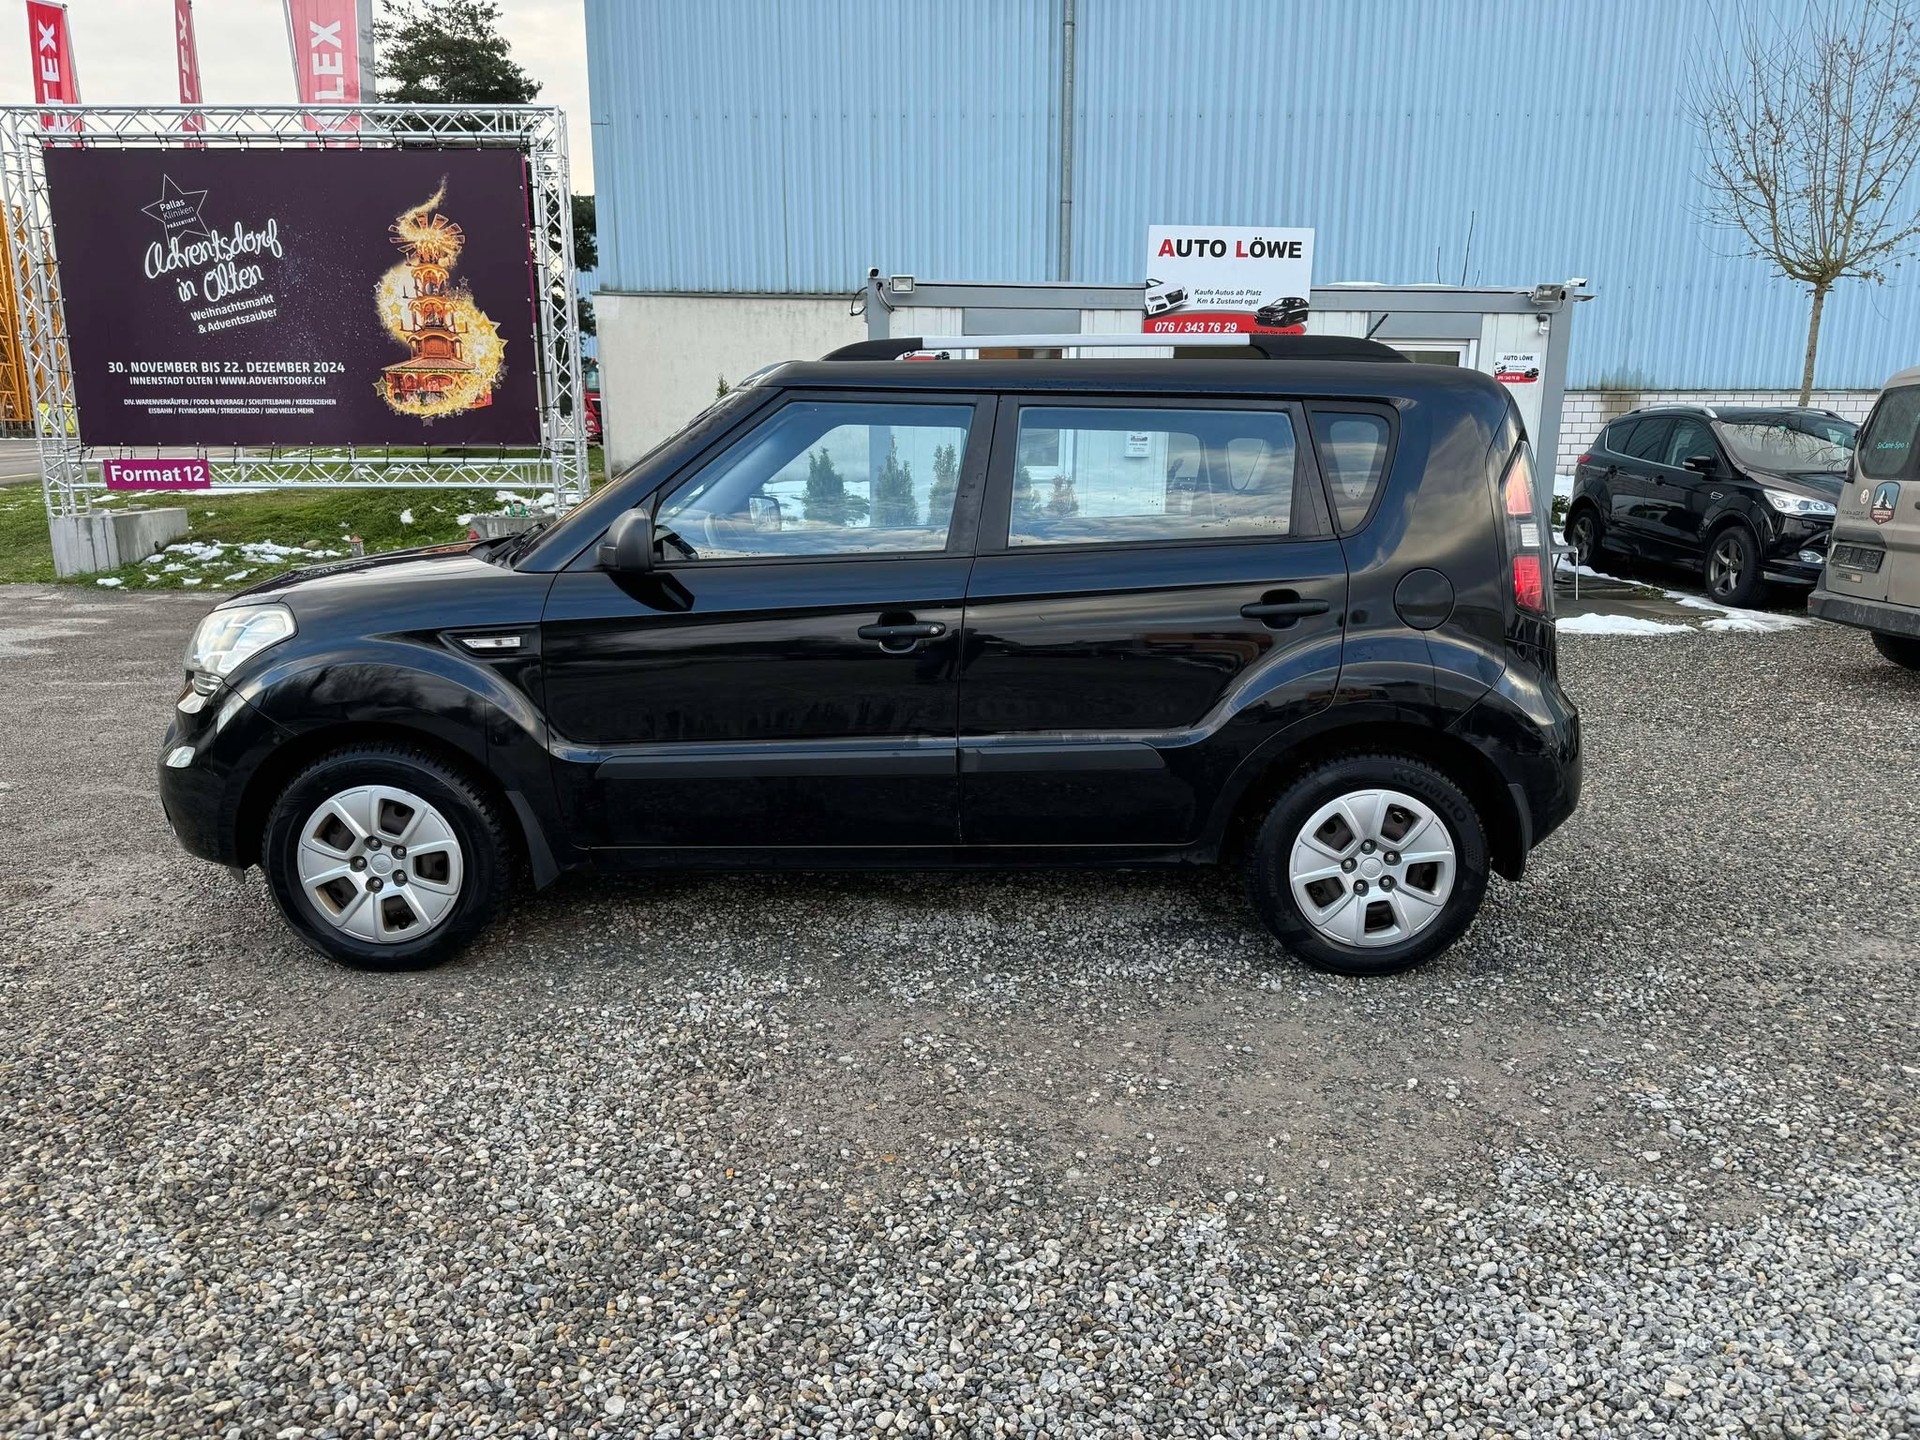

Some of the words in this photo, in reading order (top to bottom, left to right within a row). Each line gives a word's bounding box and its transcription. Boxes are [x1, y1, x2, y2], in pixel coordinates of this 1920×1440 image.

[159, 199, 186, 212] Pallas
[162, 206, 195, 220] Kliniken
[144, 218, 283, 279] Adventsdorf
[1158, 239, 1226, 258] AUTO
[1235, 237, 1303, 259] LÖWE
[176, 278, 198, 302] in
[203, 261, 264, 302] Olten
[1245, 289, 1262, 297] Platz
[190, 293, 275, 322] Weihnachtsmarkt
[1196, 297, 1209, 305] Km
[1209, 297, 1215, 305] &
[1216, 298, 1244, 306] Zustand
[198, 324, 208, 334] &
[207, 308, 278, 332] Adventszauber
[1155, 322, 1175, 333] 076
[1184, 322, 1204, 333] 343
[1207, 323, 1221, 333] 76
[1224, 322, 1238, 333] 29
[107, 361, 128, 373] 30.
[130, 361, 199, 373] NOVEMBER
[201, 361, 220, 373] BIS
[223, 361, 244, 373] 22.
[246, 361, 311, 373] DEZEMBER
[313, 361, 346, 373] 2024
[129, 376, 184, 385] INNENSTADT
[186, 376, 213, 385] OLTEN
[219, 376, 326, 385] WWW.ADVENTSDORF.CH
[193, 398, 209, 406] FOOD
[198, 407, 217, 415] SANTA
[110, 465, 181, 482] Format
[183, 465, 206, 482] 12
